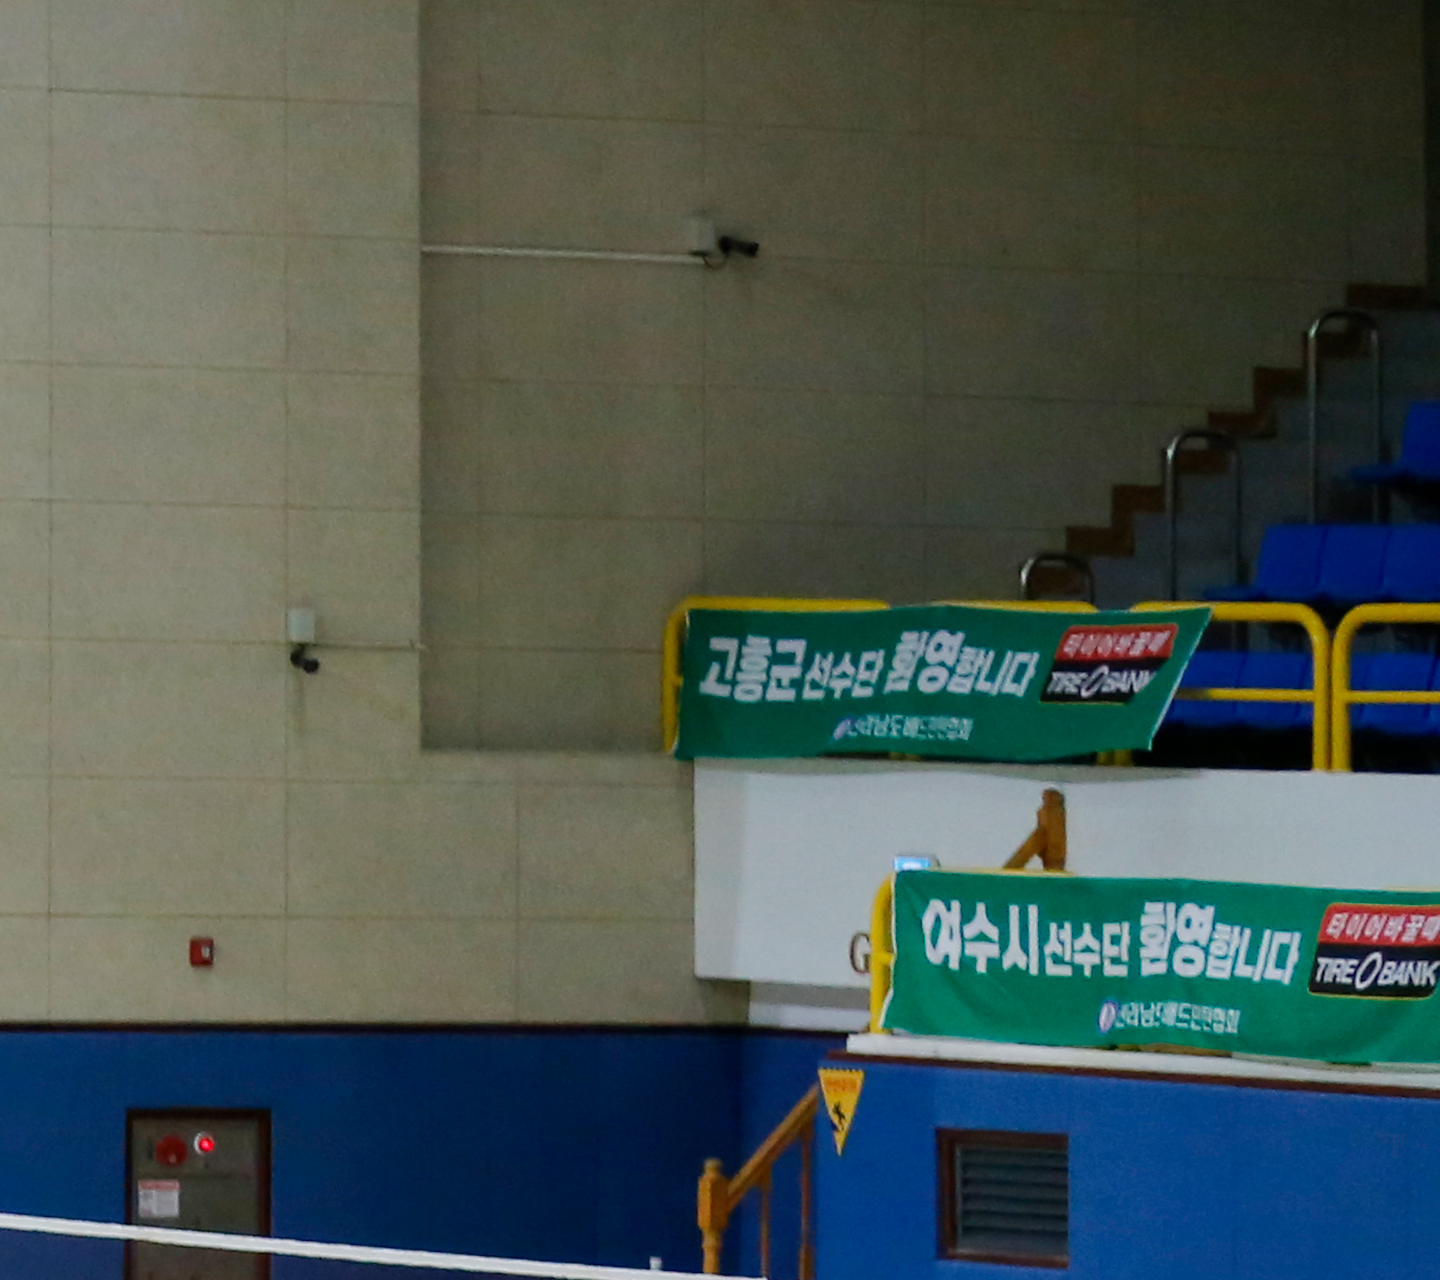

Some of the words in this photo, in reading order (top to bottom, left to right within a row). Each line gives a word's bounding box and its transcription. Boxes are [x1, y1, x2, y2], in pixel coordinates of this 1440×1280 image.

[699, 633, 807, 703] 고흥군
[801, 649, 885, 699] 선수단
[884, 628, 1041, 698] 환영합니다
[921, 898, 1038, 975] 여수시
[1043, 921, 1129, 977] 선수단
[1139, 900, 1302, 985] 환영합니다
